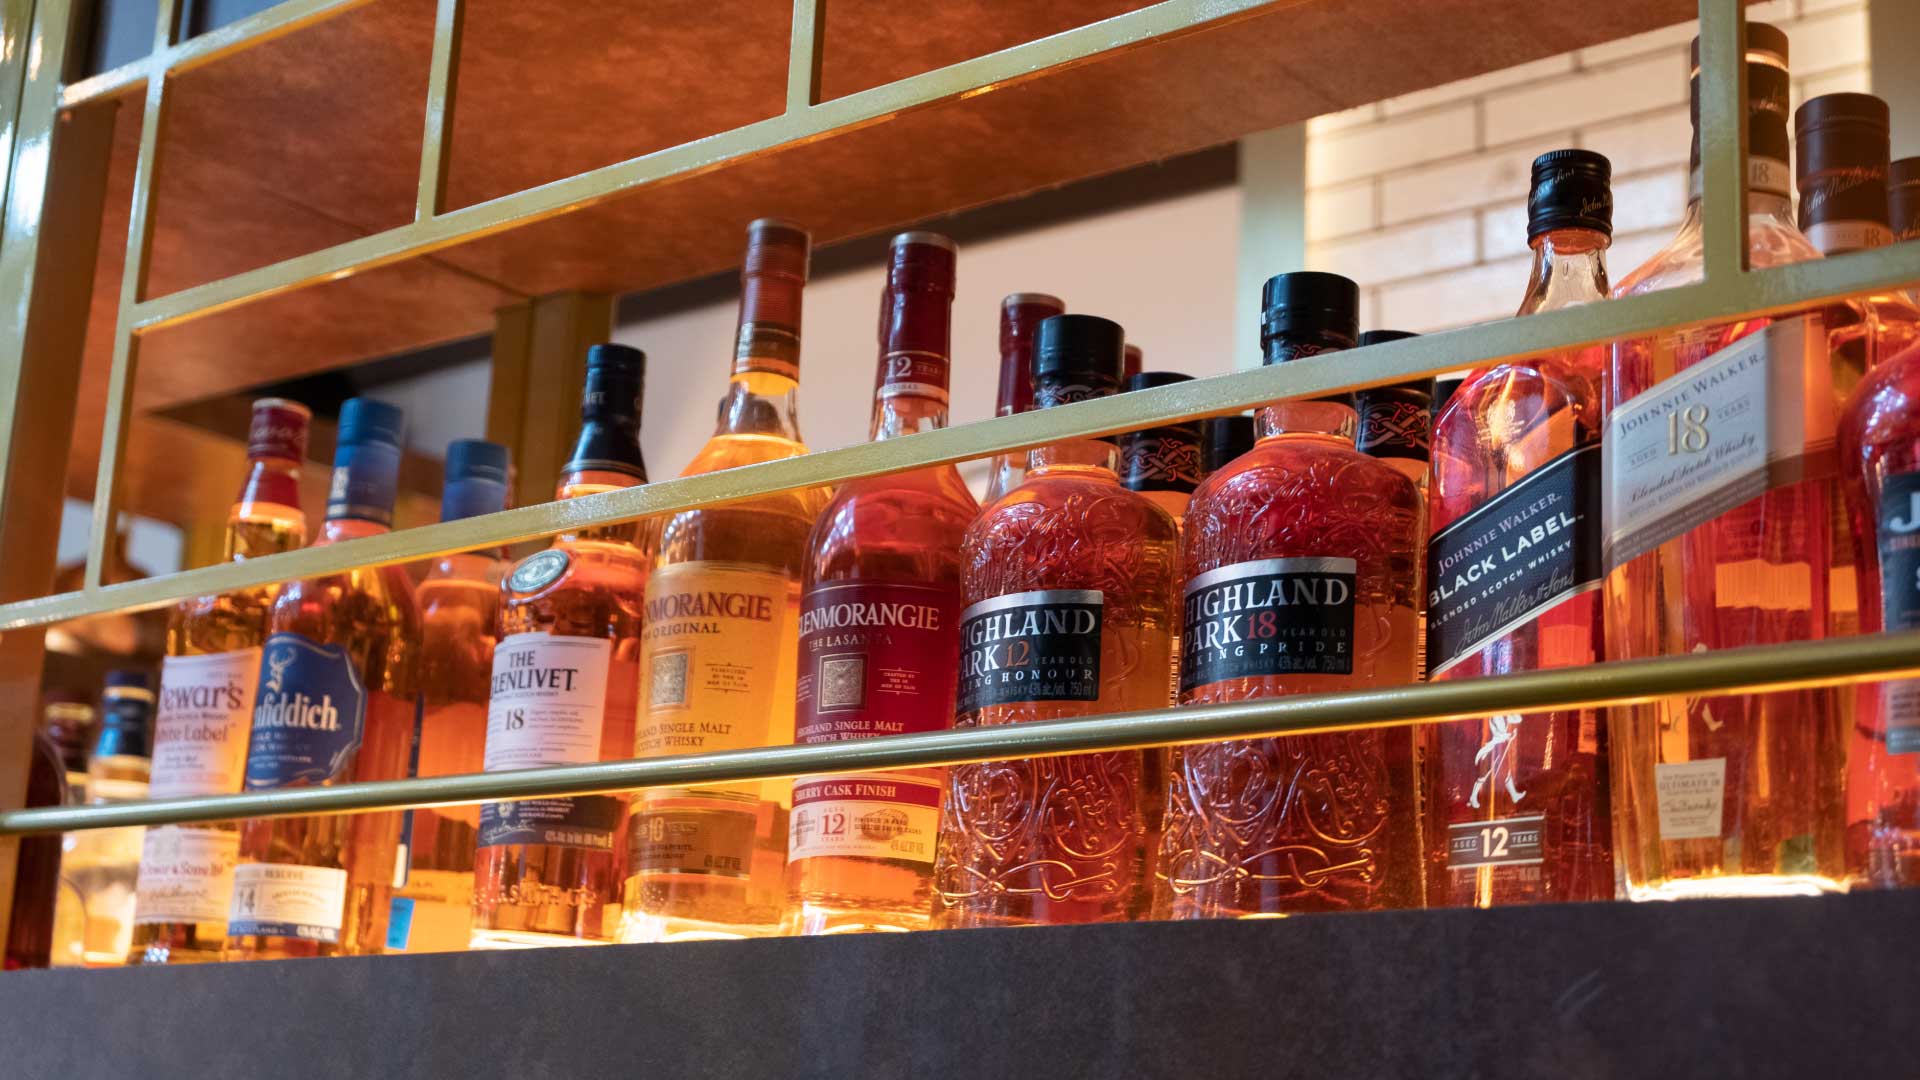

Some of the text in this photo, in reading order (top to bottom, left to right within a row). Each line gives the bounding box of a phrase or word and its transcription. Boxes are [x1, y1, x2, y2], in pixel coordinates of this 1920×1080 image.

[887, 357, 912, 377] 12
[1619, 353, 1760, 440] JOHNNIE WALKER
[1667, 403, 1710, 457] 18
[1438, 493, 1557, 576] JOHNNIE WALKER
[1428, 554, 1497, 608] BLACK
[1501, 512, 1576, 562] LABEL
[1430, 539, 1573, 630] BLENDED SCOTCH WHISKY
[1186, 578, 1349, 626] HIGHLAND
[653, 622, 721, 638] ORIGINAL
[799, 602, 941, 637] LENMORANGIE
[826, 633, 893, 648] LASAA
[1184, 614, 1244, 657] PARK
[1247, 611, 1278, 640] 18
[1453, 614, 1491, 657] John
[508, 650, 536, 668] THE
[960, 643, 1001, 680] ARK
[1005, 640, 1030, 669] 12
[1259, 642, 1346, 655] PRIDE
[492, 668, 578, 695] LENLIVET
[1002, 669, 1094, 684] HONOUR
[505, 707, 525, 731] 18
[659, 722, 695, 733] SINGLE
[700, 721, 732, 735] MALT
[834, 720, 871, 731] SINGLE
[874, 721, 905, 732] MALT
[184, 723, 229, 742] Label
[664, 735, 705, 748] WHISKY
[823, 784, 853, 797] CASK
[855, 783, 897, 798] FINISH
[649, 816, 665, 842] 10
[822, 813, 845, 835] 12
[1453, 827, 1538, 858] AGED 12 YEARS
